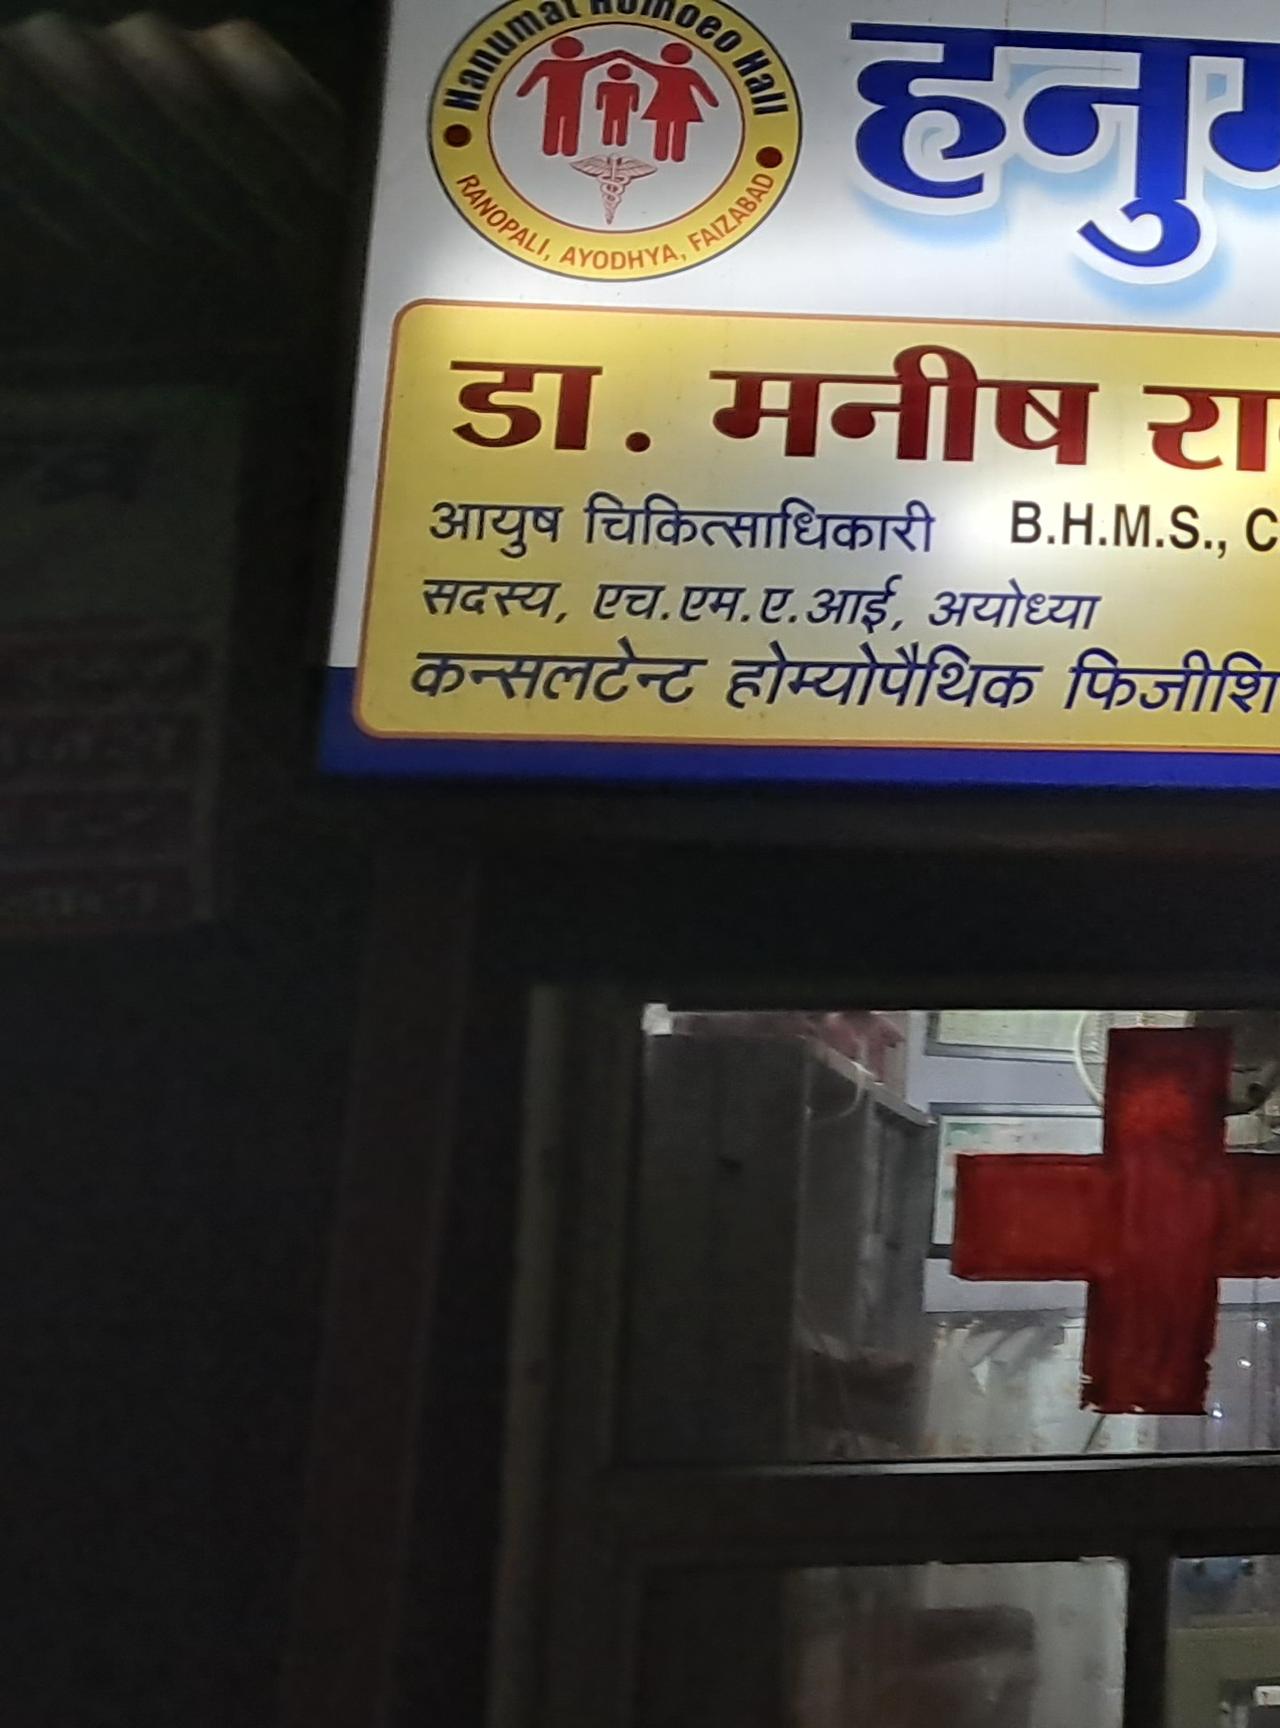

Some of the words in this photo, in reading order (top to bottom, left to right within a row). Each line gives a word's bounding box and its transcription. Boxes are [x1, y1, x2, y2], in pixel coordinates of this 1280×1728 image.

[444, 0, 580, 112] Hanumat
[592, 0, 741, 53] Homoeo
[732, 49, 789, 117] Hall
[456, 173, 551, 263] RANOPALI,
[559, 244, 687, 271] AYODHYA,
[687, 171, 776, 254] FAIZABAD
[711, 345, 1098, 466] मनीष
[429, 501, 562, 558] आयुष
[584, 494, 936, 553] चिकित्साधिकारी
[1010, 499, 1228, 559] B.H.M.S.,
[421, 577, 567, 624] सदस्य,
[594, 574, 903, 632] एच.एम.ए.आई,
[927, 579, 1102, 631] अयोध्या
[410, 637, 707, 704] कन्सलटेन्ट
[726, 640, 1042, 710] होम्योपैथिक
